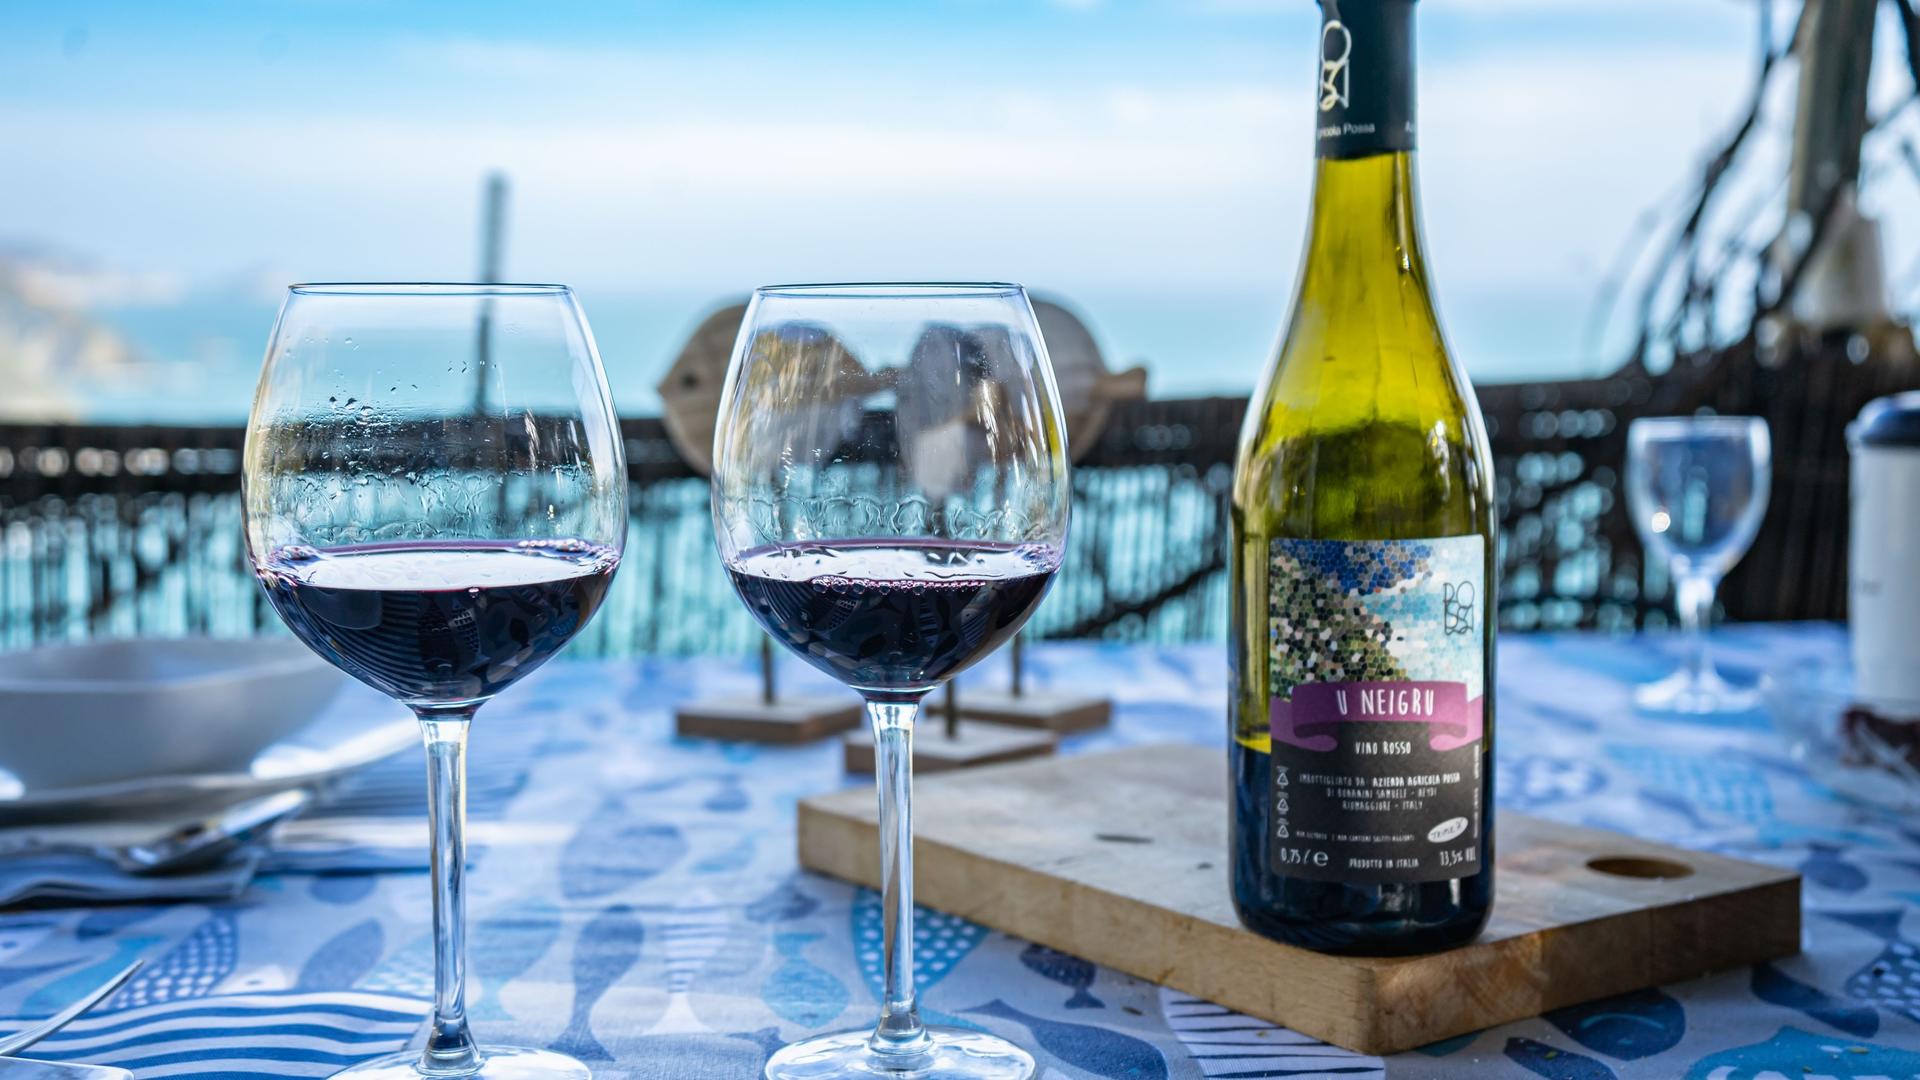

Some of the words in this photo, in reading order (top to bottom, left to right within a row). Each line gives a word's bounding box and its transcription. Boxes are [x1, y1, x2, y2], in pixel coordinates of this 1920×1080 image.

[1343, 122, 1375, 135] Possa
[1336, 689, 1348, 715] U
[1361, 688, 1434, 716] NEIGRU
[1355, 741, 1378, 755] VINO
[1383, 740, 1412, 755] ROSSO
[1372, 776, 1405, 788] AZIENDA
[1407, 774, 1440, 786] AGRICOLA
[1442, 772, 1461, 784] POSSA
[1375, 788, 1407, 799] SAMUELE
[1342, 800, 1391, 811] RIOMAGGIORE
[1402, 800, 1423, 811] ITALY
[1348, 858, 1383, 868] PRODOTTO
[1385, 859, 1394, 868] IN
[1396, 858, 1420, 868] ITALIA
